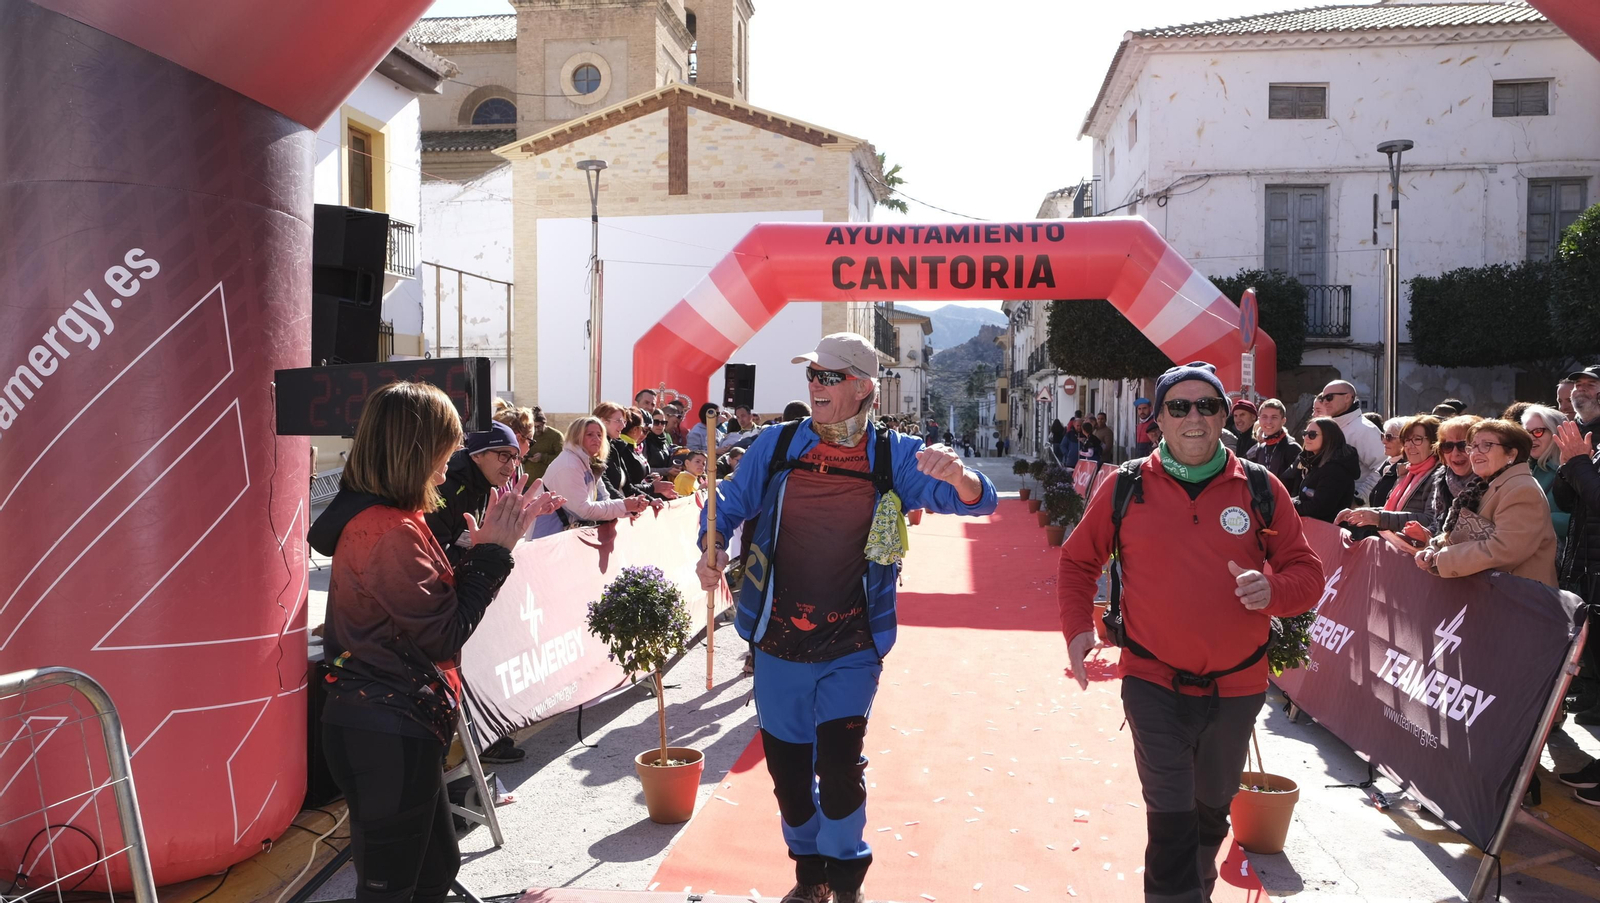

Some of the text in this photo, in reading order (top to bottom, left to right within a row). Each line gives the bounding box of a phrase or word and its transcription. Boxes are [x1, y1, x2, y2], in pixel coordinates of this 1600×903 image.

[825, 223, 1065, 245] AYUNTAMIENTO
[832, 254, 1056, 290] CANTORIA
[0, 247, 161, 432] amergy.es
[495, 625, 585, 700] TEAMERGY
[1376, 647, 1497, 727] TEAMERGY
[1383, 705, 1440, 749] www.teamergy.es
